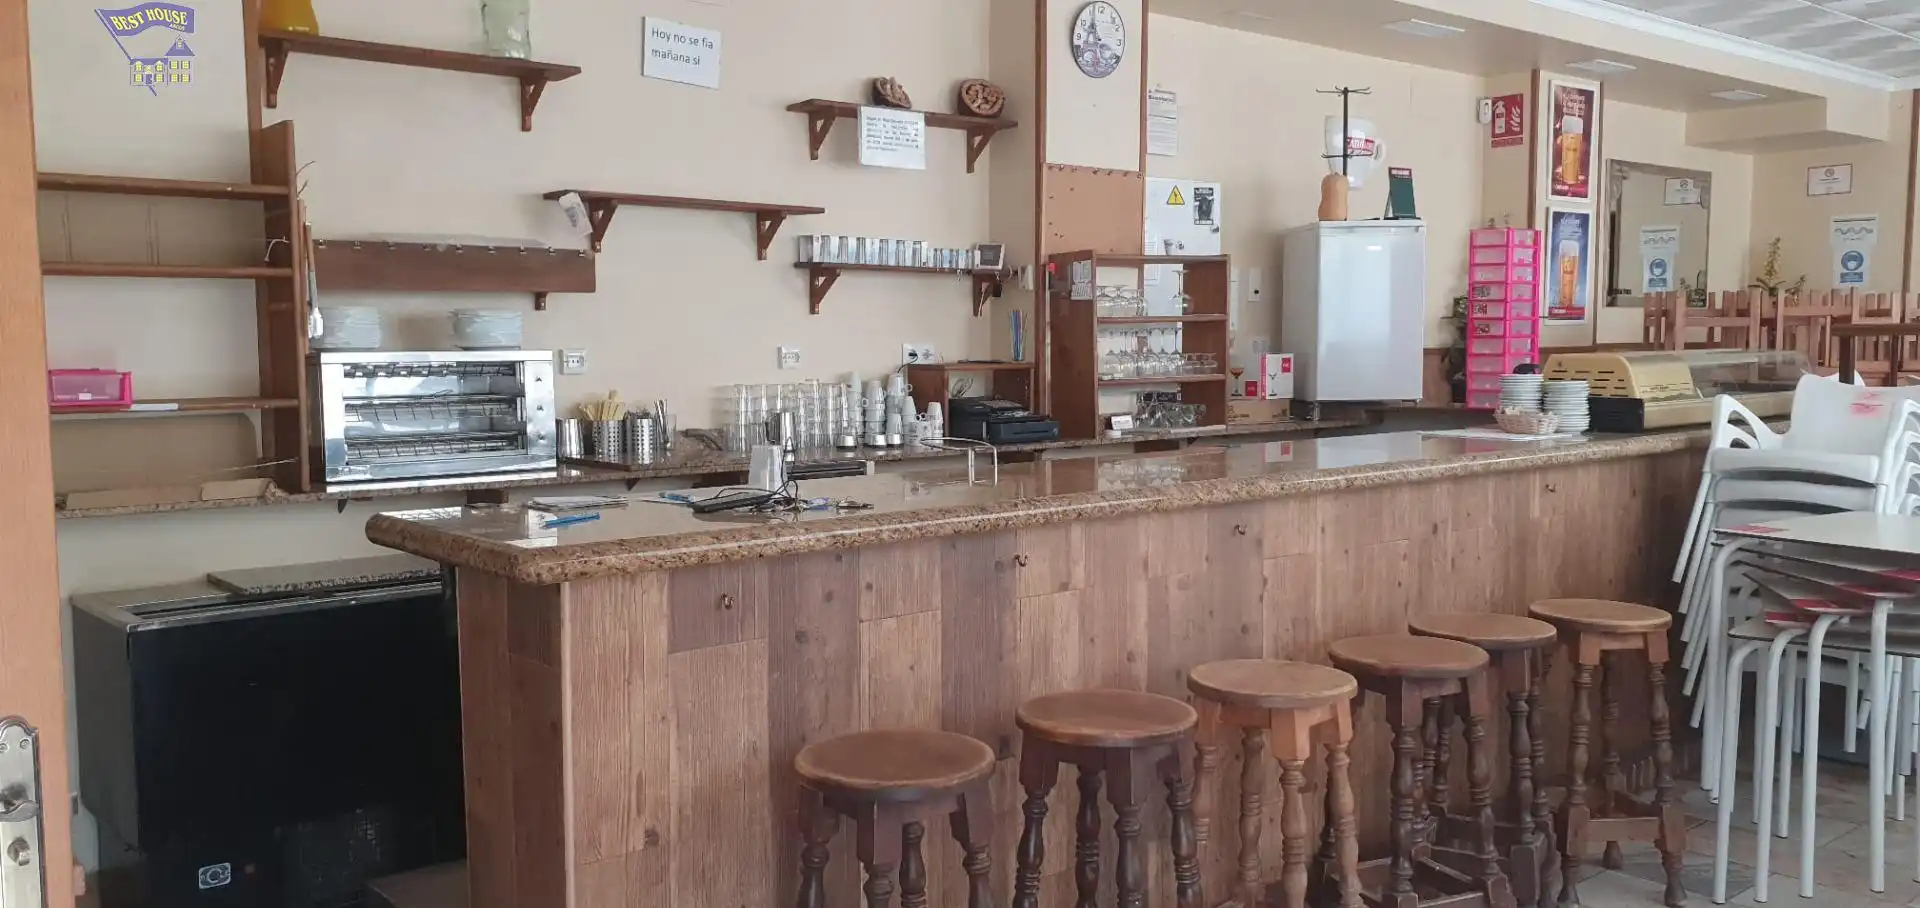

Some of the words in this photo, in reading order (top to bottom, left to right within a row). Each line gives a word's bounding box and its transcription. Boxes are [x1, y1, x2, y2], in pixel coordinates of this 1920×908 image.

[1098, 6, 1105, 14] 12
[651, 27, 671, 43] Hoy
[673, 33, 687, 44] no
[688, 37, 699, 46] se
[1116, 38, 1121, 46] 3
[651, 48, 691, 64] mañana
